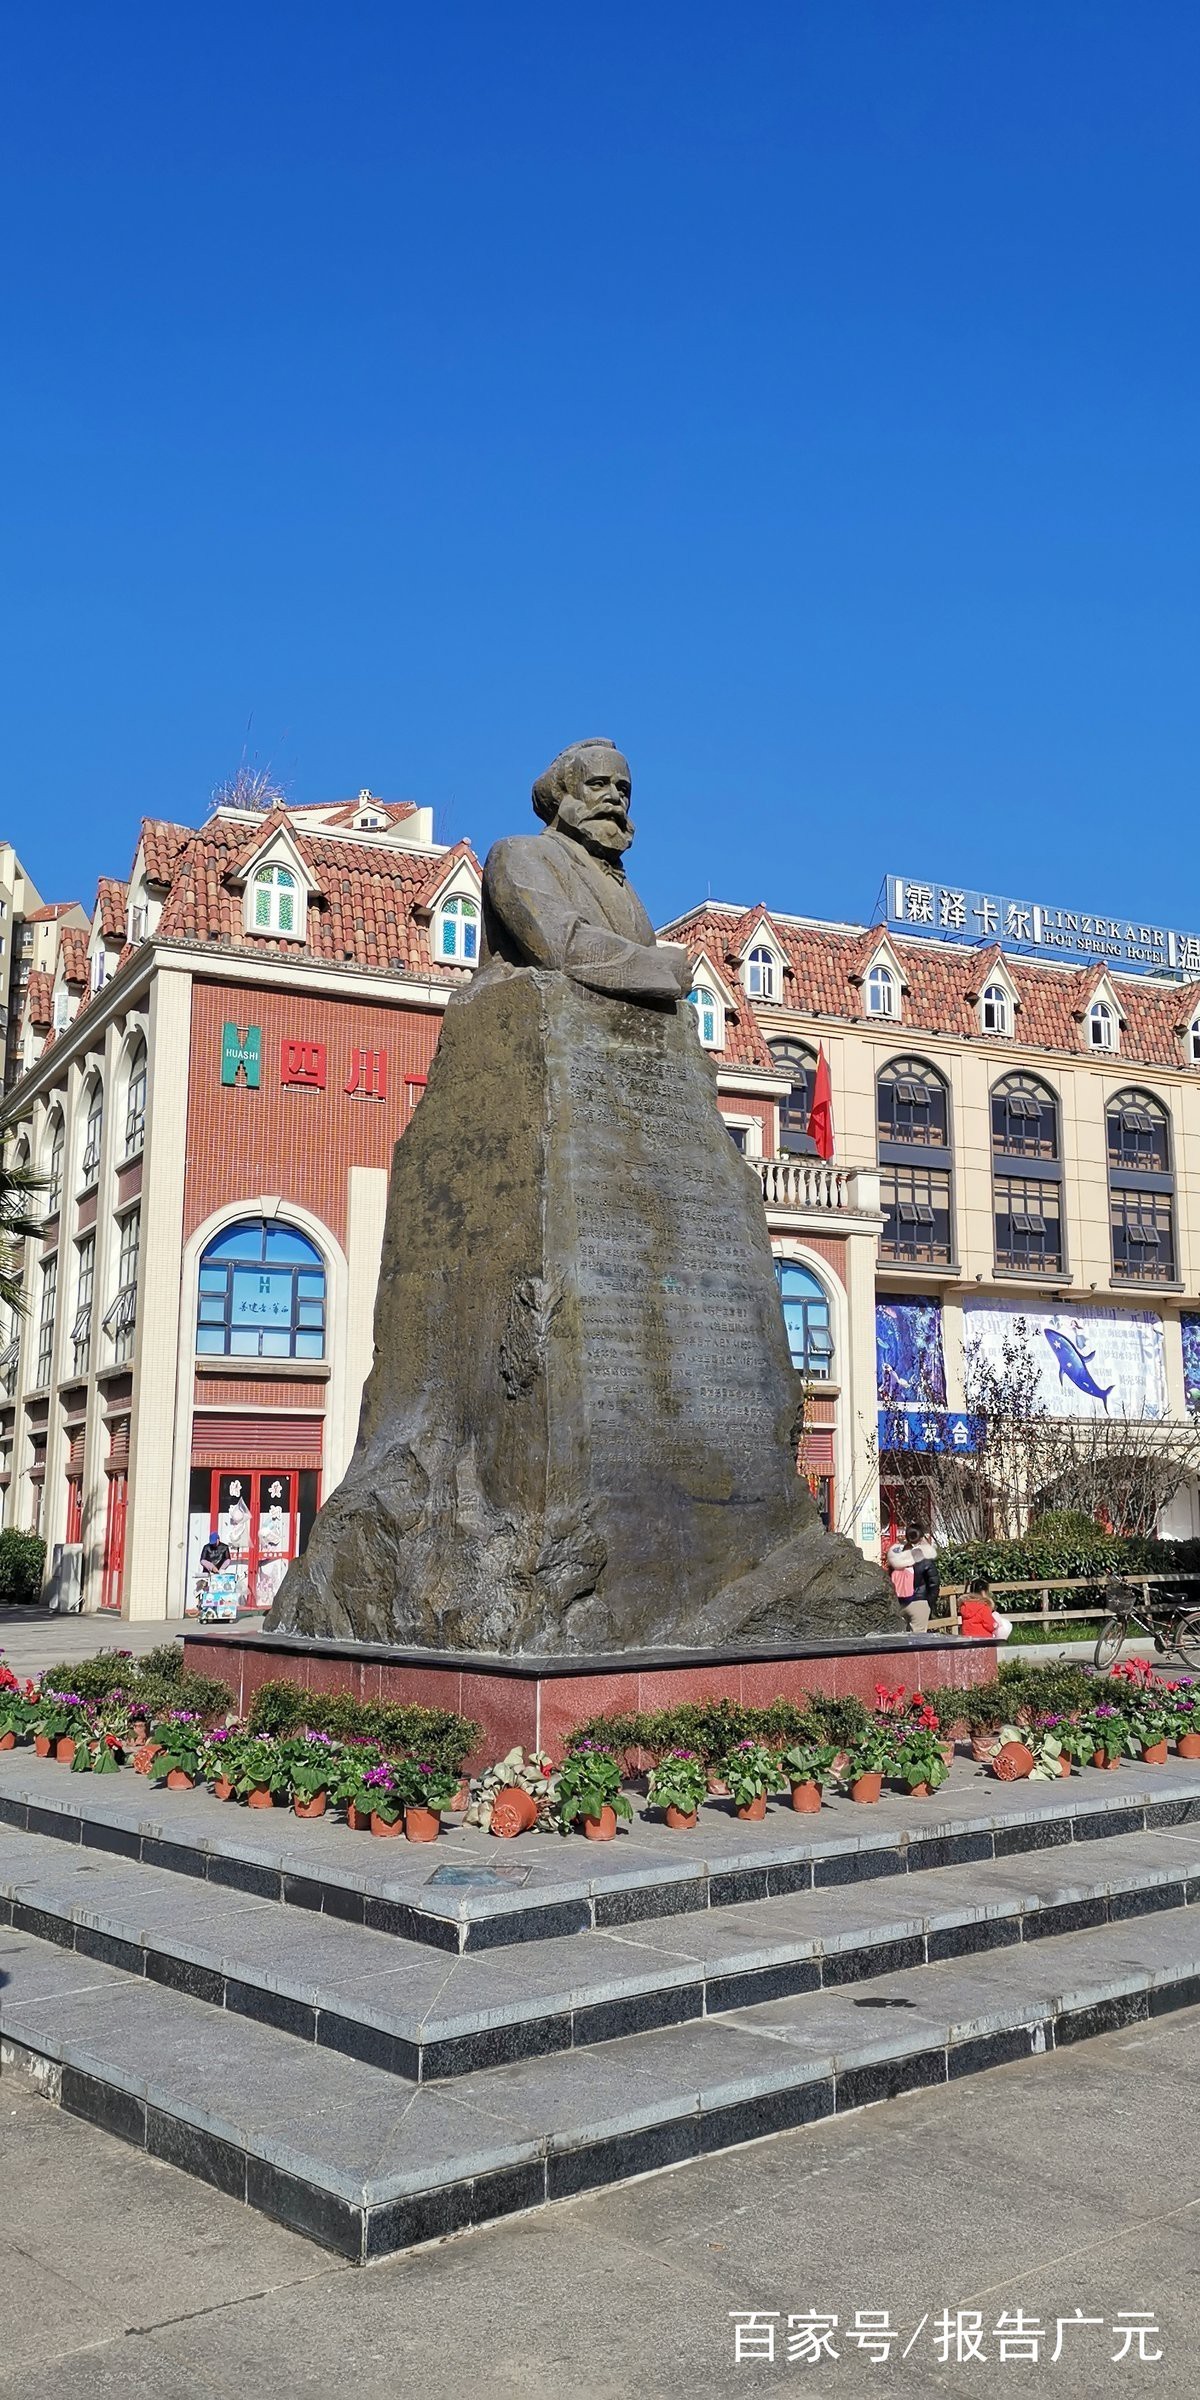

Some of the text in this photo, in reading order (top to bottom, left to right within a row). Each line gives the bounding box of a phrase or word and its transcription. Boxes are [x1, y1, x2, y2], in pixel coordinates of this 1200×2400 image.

[905, 885, 1031, 940] 霖泽卡尔
[1043, 910, 1165, 947] LINZEKAER
[1045, 931, 1167, 965] HOT SPRING HOTEL
[226, 1048, 258, 1061] HUASHI
